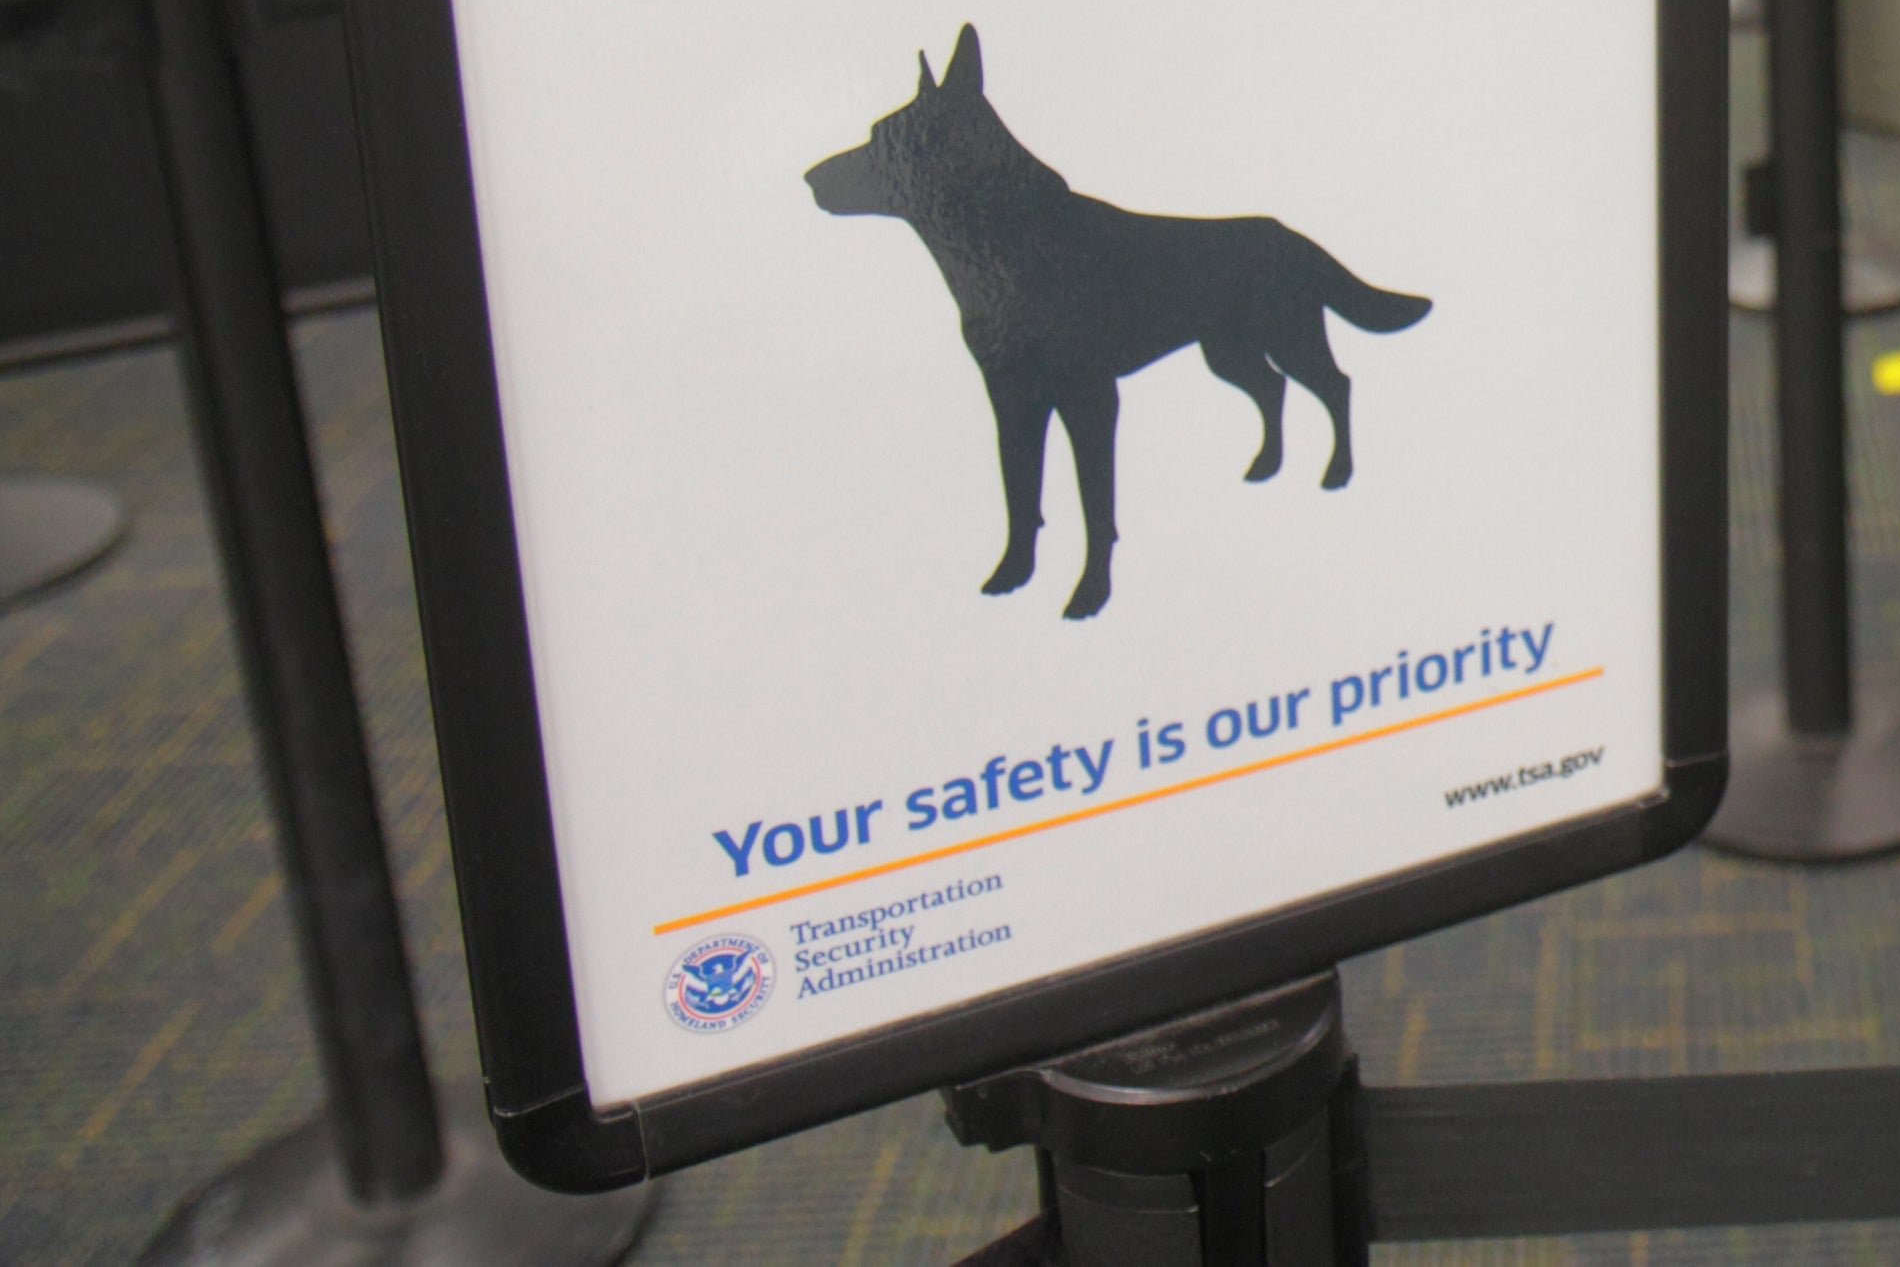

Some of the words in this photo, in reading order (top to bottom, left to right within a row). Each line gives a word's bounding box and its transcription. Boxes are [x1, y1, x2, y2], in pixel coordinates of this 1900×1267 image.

[713, 801, 884, 878] Your
[905, 736, 1115, 832] safety
[1136, 719, 1187, 770] is
[1206, 690, 1310, 750] our
[1330, 621, 1554, 727] priority
[1444, 746, 1604, 808] www.tsa.gov
[790, 874, 1003, 946] Transportation
[795, 924, 915, 973] Security
[797, 923, 1013, 1000] Administration
